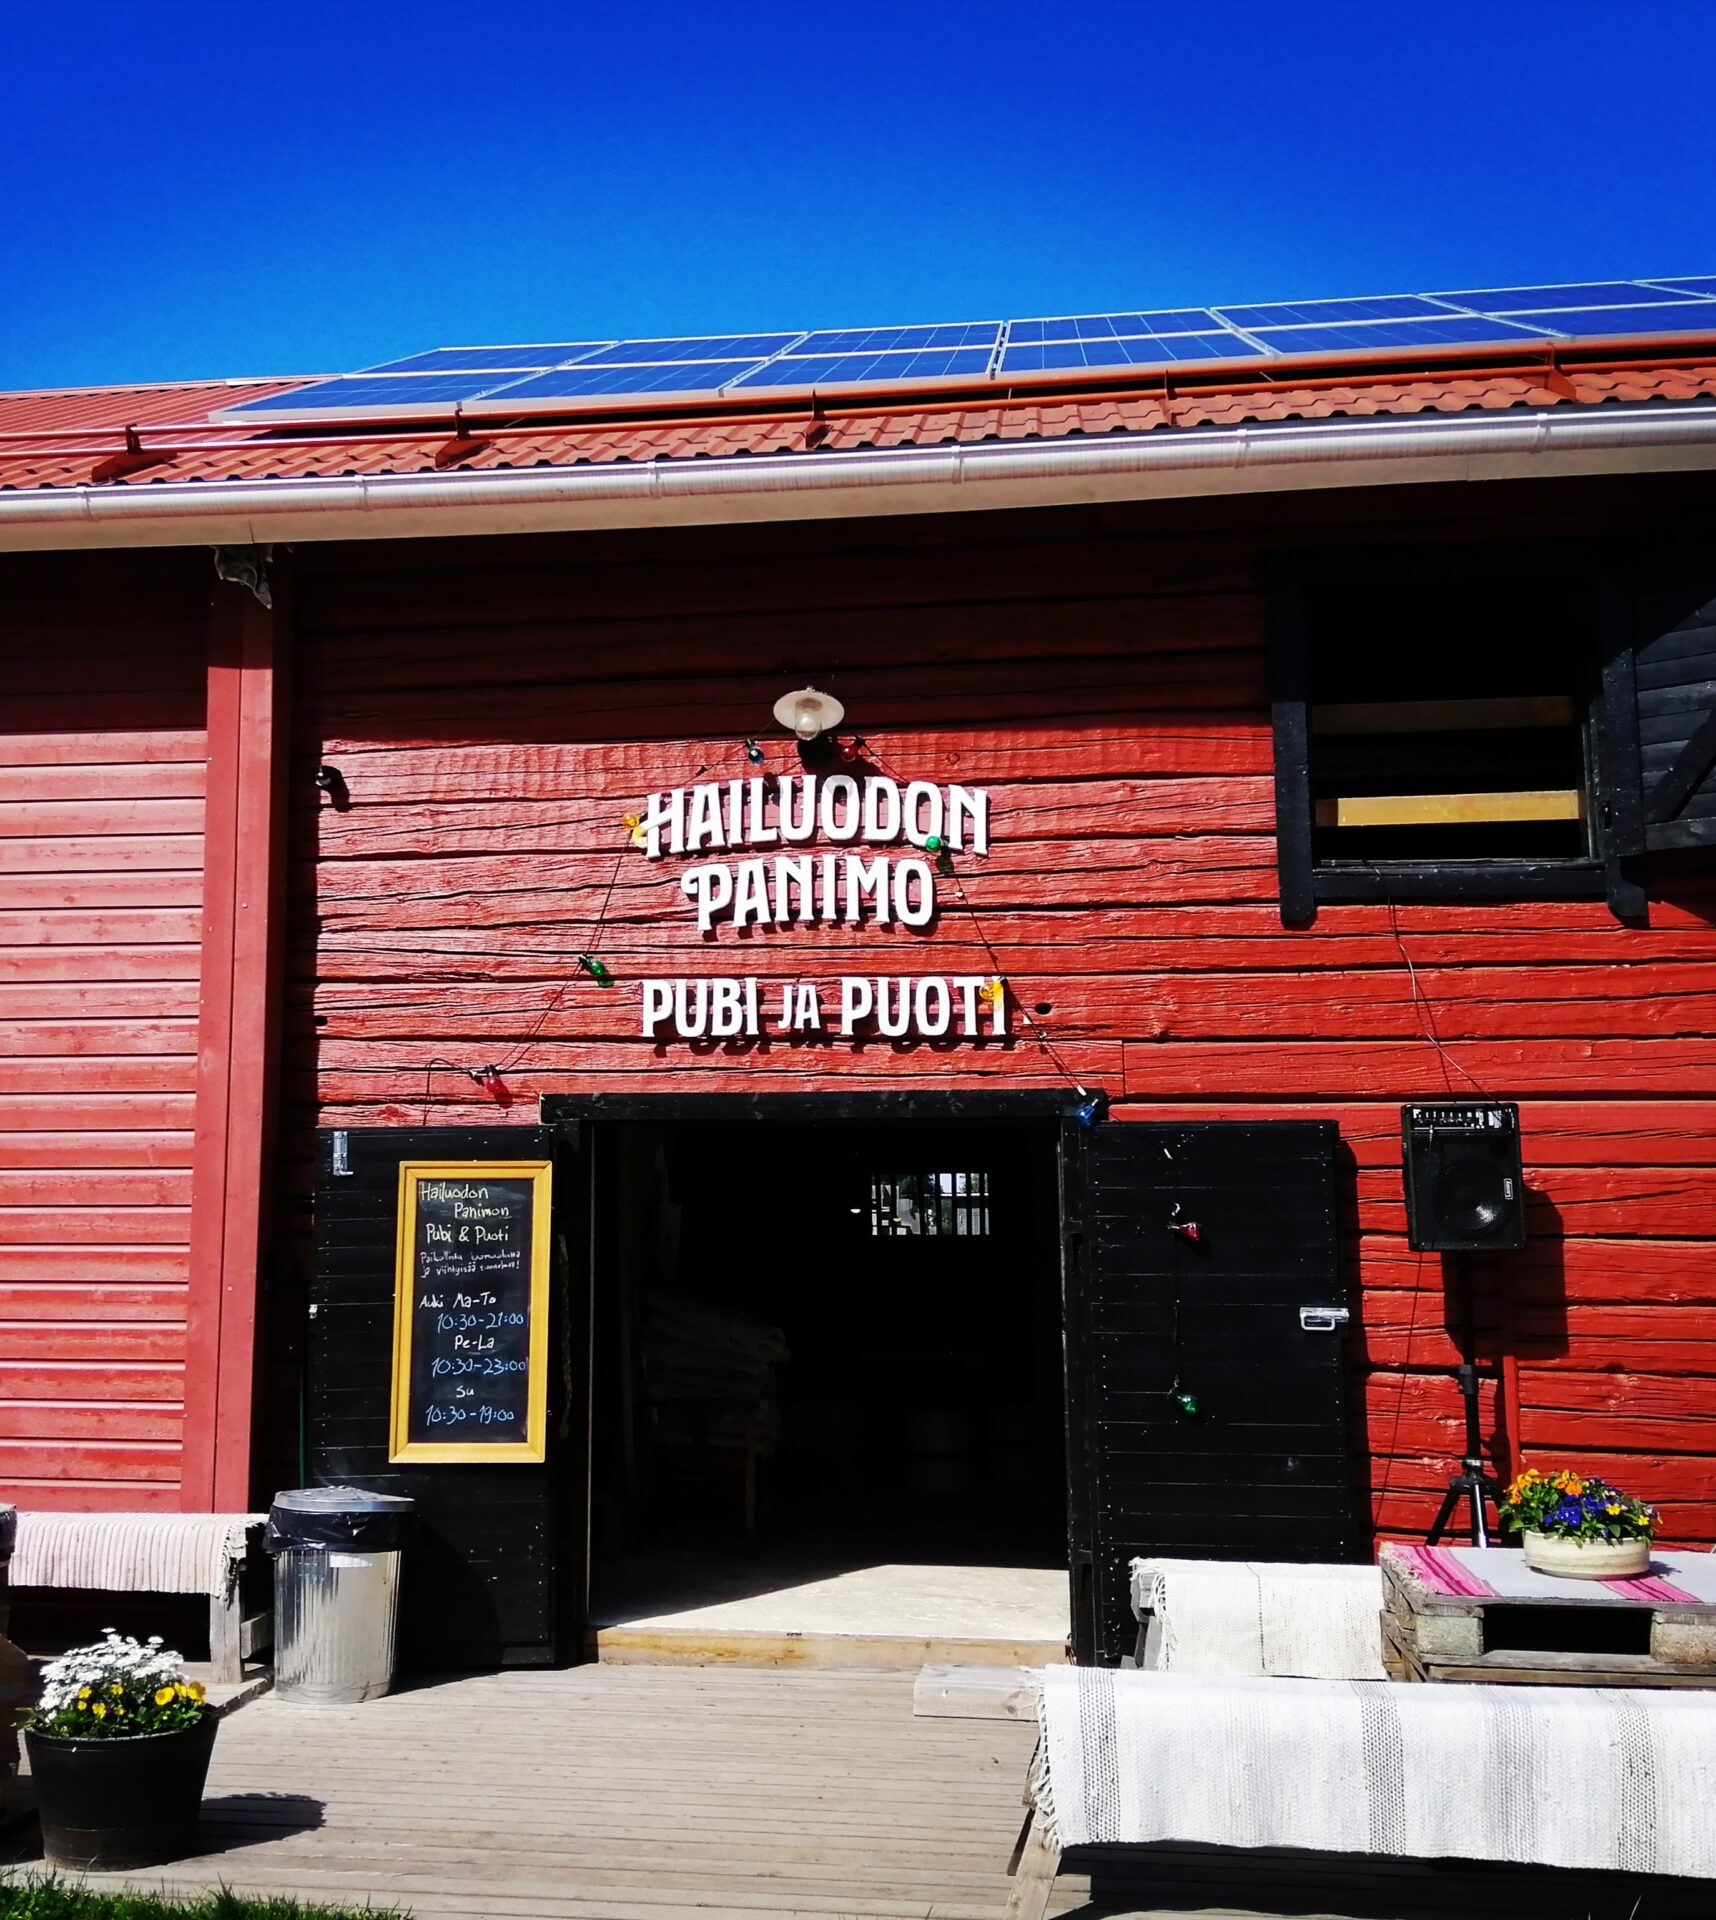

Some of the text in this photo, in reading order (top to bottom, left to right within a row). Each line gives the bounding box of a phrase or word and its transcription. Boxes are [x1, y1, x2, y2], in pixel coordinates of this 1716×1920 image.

[632, 775, 989, 860] HAILUODON
[681, 855, 934, 931] PANIMO
[641, 976, 1007, 1038] PUBI JA PUOTI
[419, 1182, 489, 1202] Hailuodon
[454, 1203, 509, 1219] Panimon
[426, 1223, 509, 1245] Pubi & Puoti
[419, 1294, 444, 1309] Auki
[454, 1334, 495, 1350] Pe-La
[455, 1385, 475, 1398] Su
